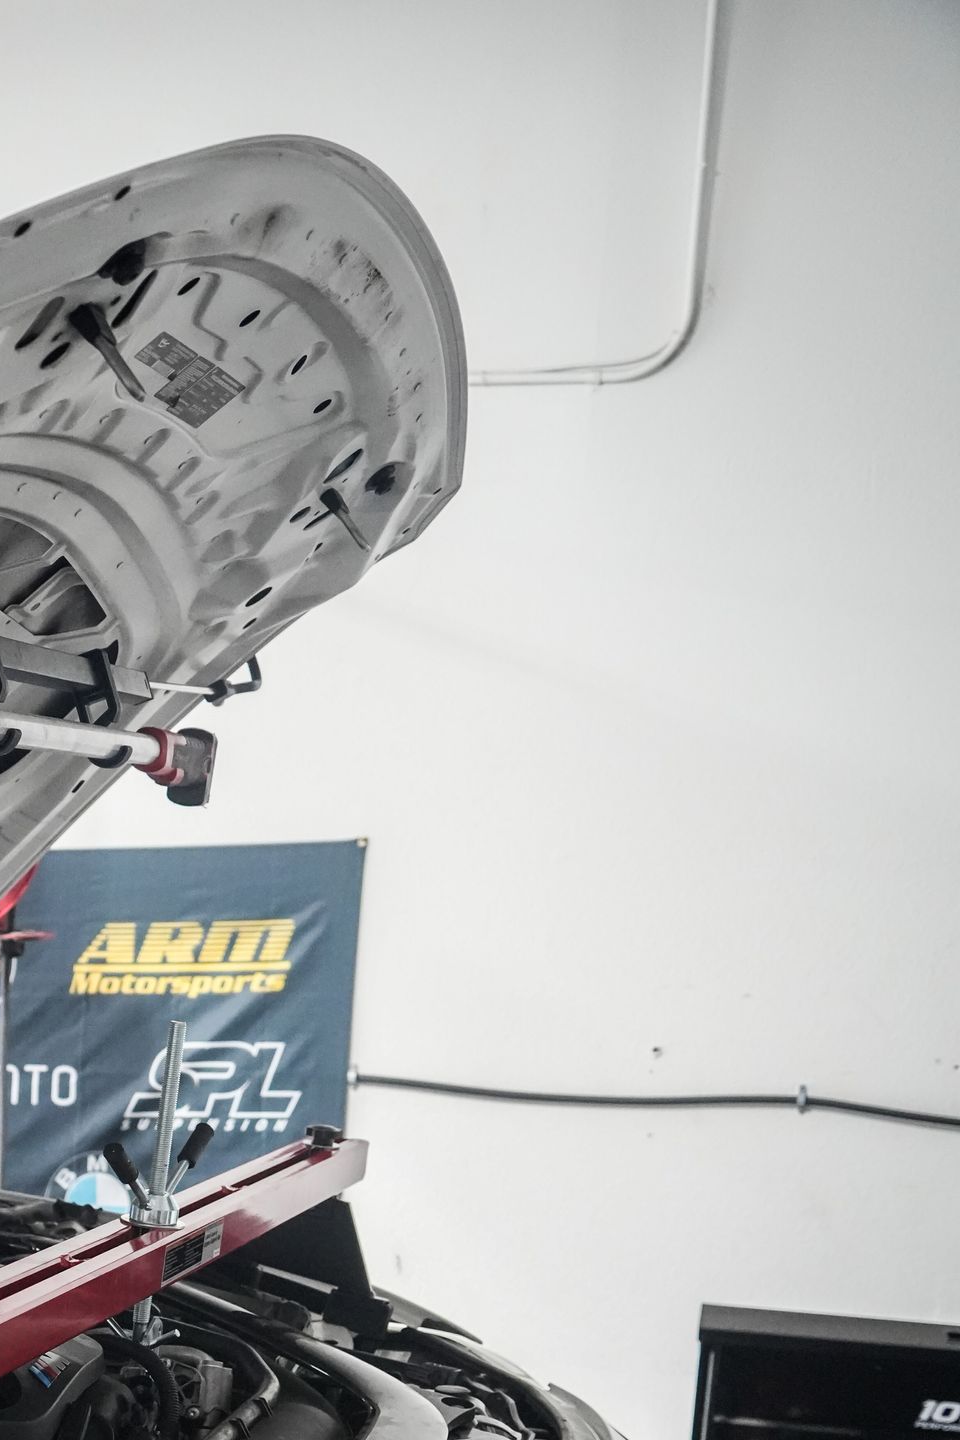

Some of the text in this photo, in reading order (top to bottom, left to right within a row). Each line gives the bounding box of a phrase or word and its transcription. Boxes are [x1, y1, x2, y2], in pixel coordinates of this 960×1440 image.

[69, 972, 288, 999] Motorsports
[124, 1041, 302, 1118] SPL
[120, 1117, 289, 1132] SUPENSION
[918, 1399, 960, 1424] 10
